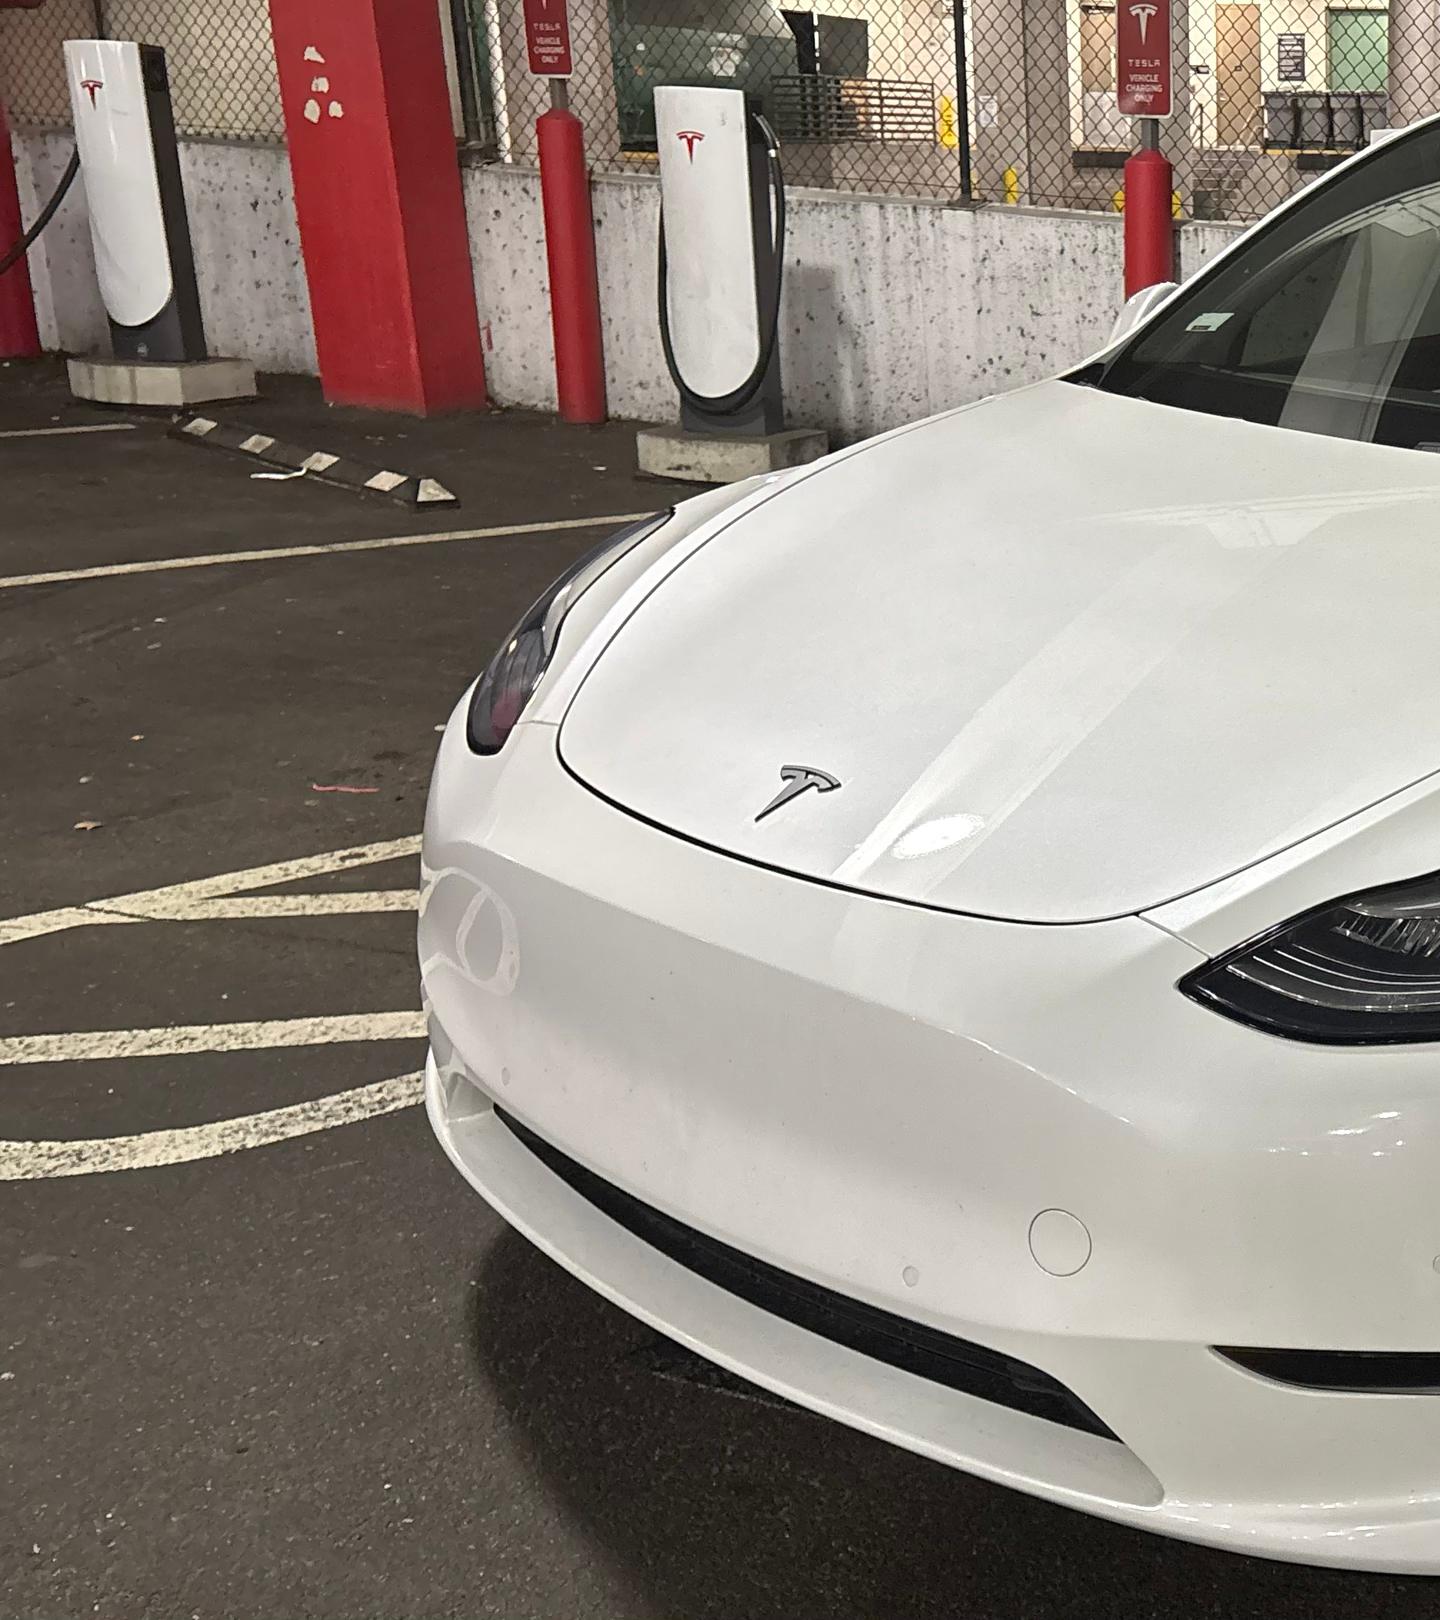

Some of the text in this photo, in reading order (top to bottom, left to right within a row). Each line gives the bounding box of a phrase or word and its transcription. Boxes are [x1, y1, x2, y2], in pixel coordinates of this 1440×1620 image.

[1128, 59, 1161, 67] TESLA
[1129, 74, 1159, 82] VEHICLE
[1125, 84, 1163, 92] CHARGING
[1134, 94, 1154, 102] ONLY
